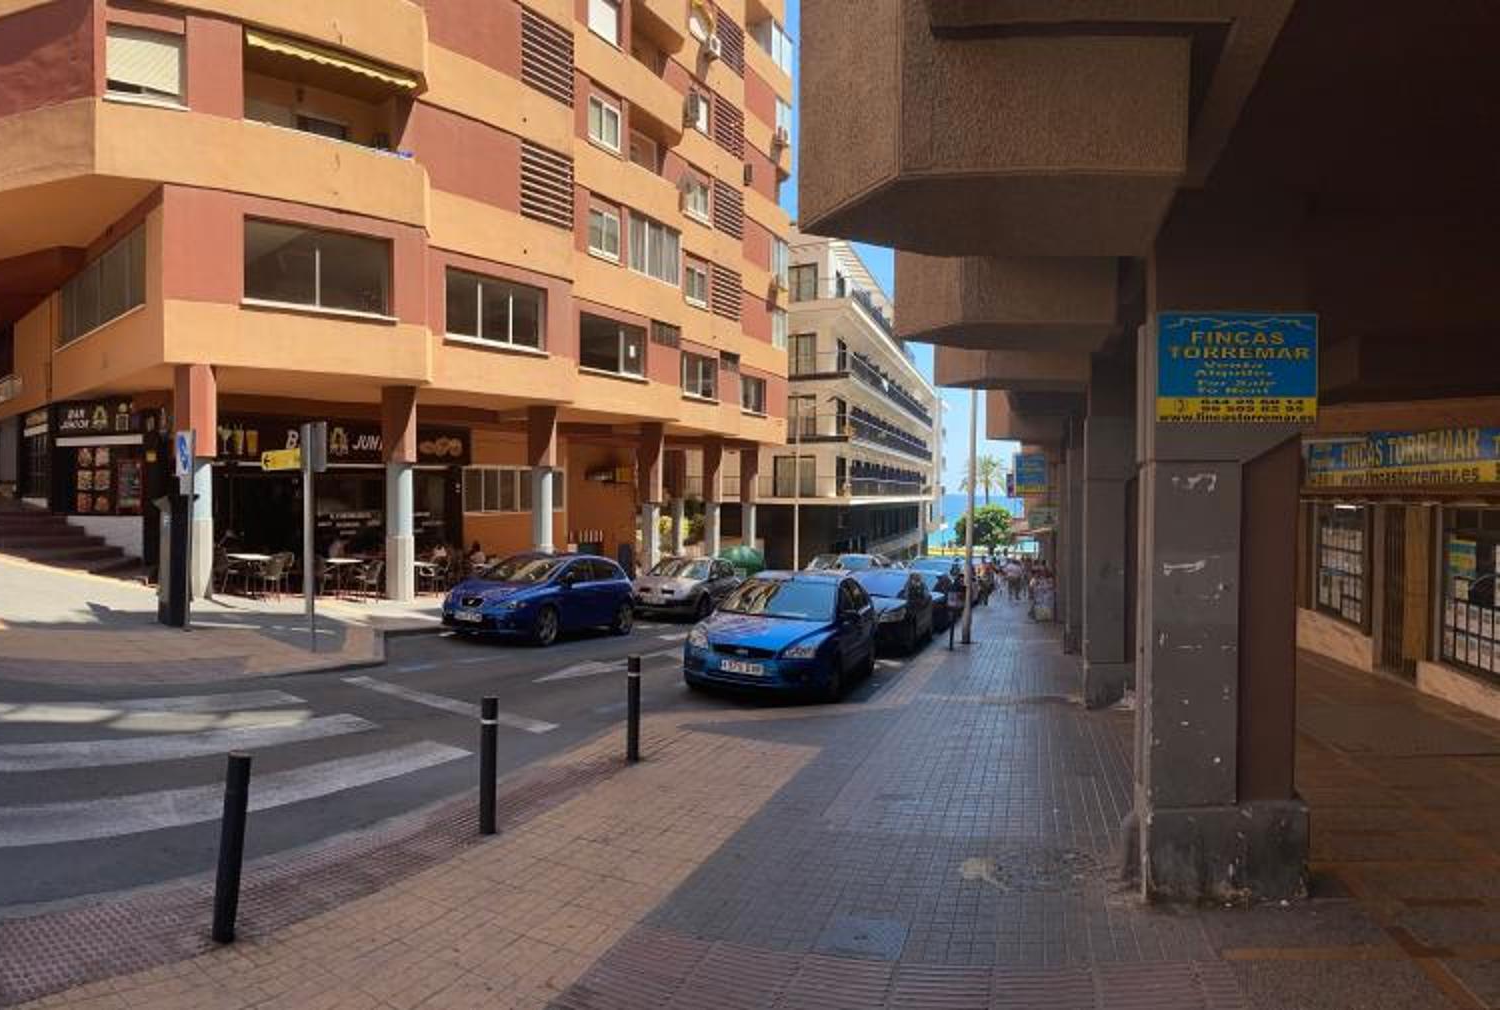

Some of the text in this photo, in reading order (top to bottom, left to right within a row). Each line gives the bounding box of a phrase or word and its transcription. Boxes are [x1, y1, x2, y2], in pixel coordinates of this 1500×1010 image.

[1191, 331, 1284, 345] FINCAS
[1170, 346, 1310, 360] TORREMAR
[352, 435, 383, 451] JUN
[1341, 440, 1384, 469] FINCAS
[1386, 428, 1479, 465] TORREMAR
